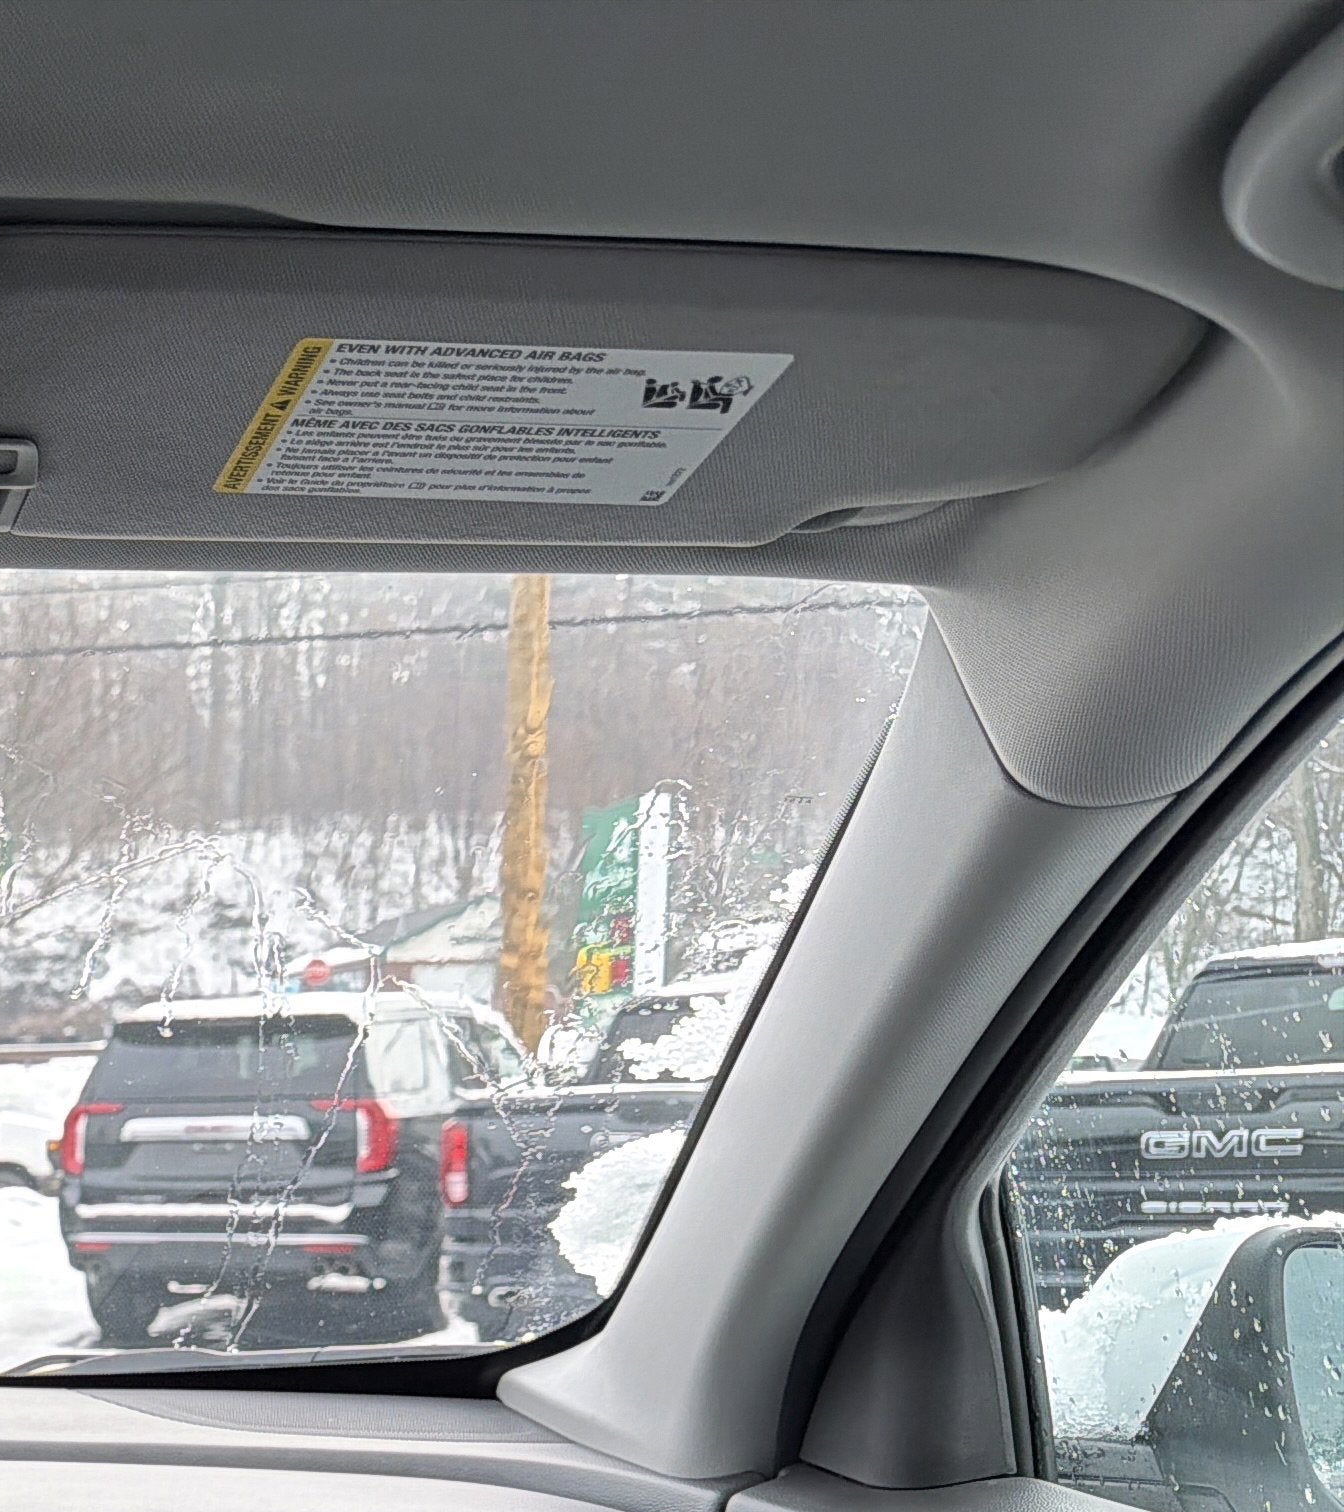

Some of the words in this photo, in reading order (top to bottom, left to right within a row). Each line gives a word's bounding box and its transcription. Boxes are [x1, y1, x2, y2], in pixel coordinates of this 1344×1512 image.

[335, 343, 381, 354] EVEN
[384, 344, 430, 356] WITH
[429, 346, 522, 360] ADVANCED
[524, 350, 556, 361] AIR
[557, 350, 608, 363] BAGS
[339, 357, 386, 367] Children
[388, 360, 408, 368] can
[411, 360, 425, 368] be
[277, 346, 323, 396] WARNING
[333, 368, 353, 376] The
[356, 369, 381, 377] back
[326, 378, 359, 387] Never
[313, 398, 336, 406] See
[291, 417, 338, 428] MÊME
[339, 421, 380, 430] AVEC
[382, 422, 412, 431] DES
[414, 423, 456, 433] SACS
[459, 424, 556, 437] GONFLABLES
[556, 427, 661, 440] INTELLIGENTS
[223, 412, 282, 490] AVERTISSEMENT
[1140, 1128, 1304, 1160] GMC
